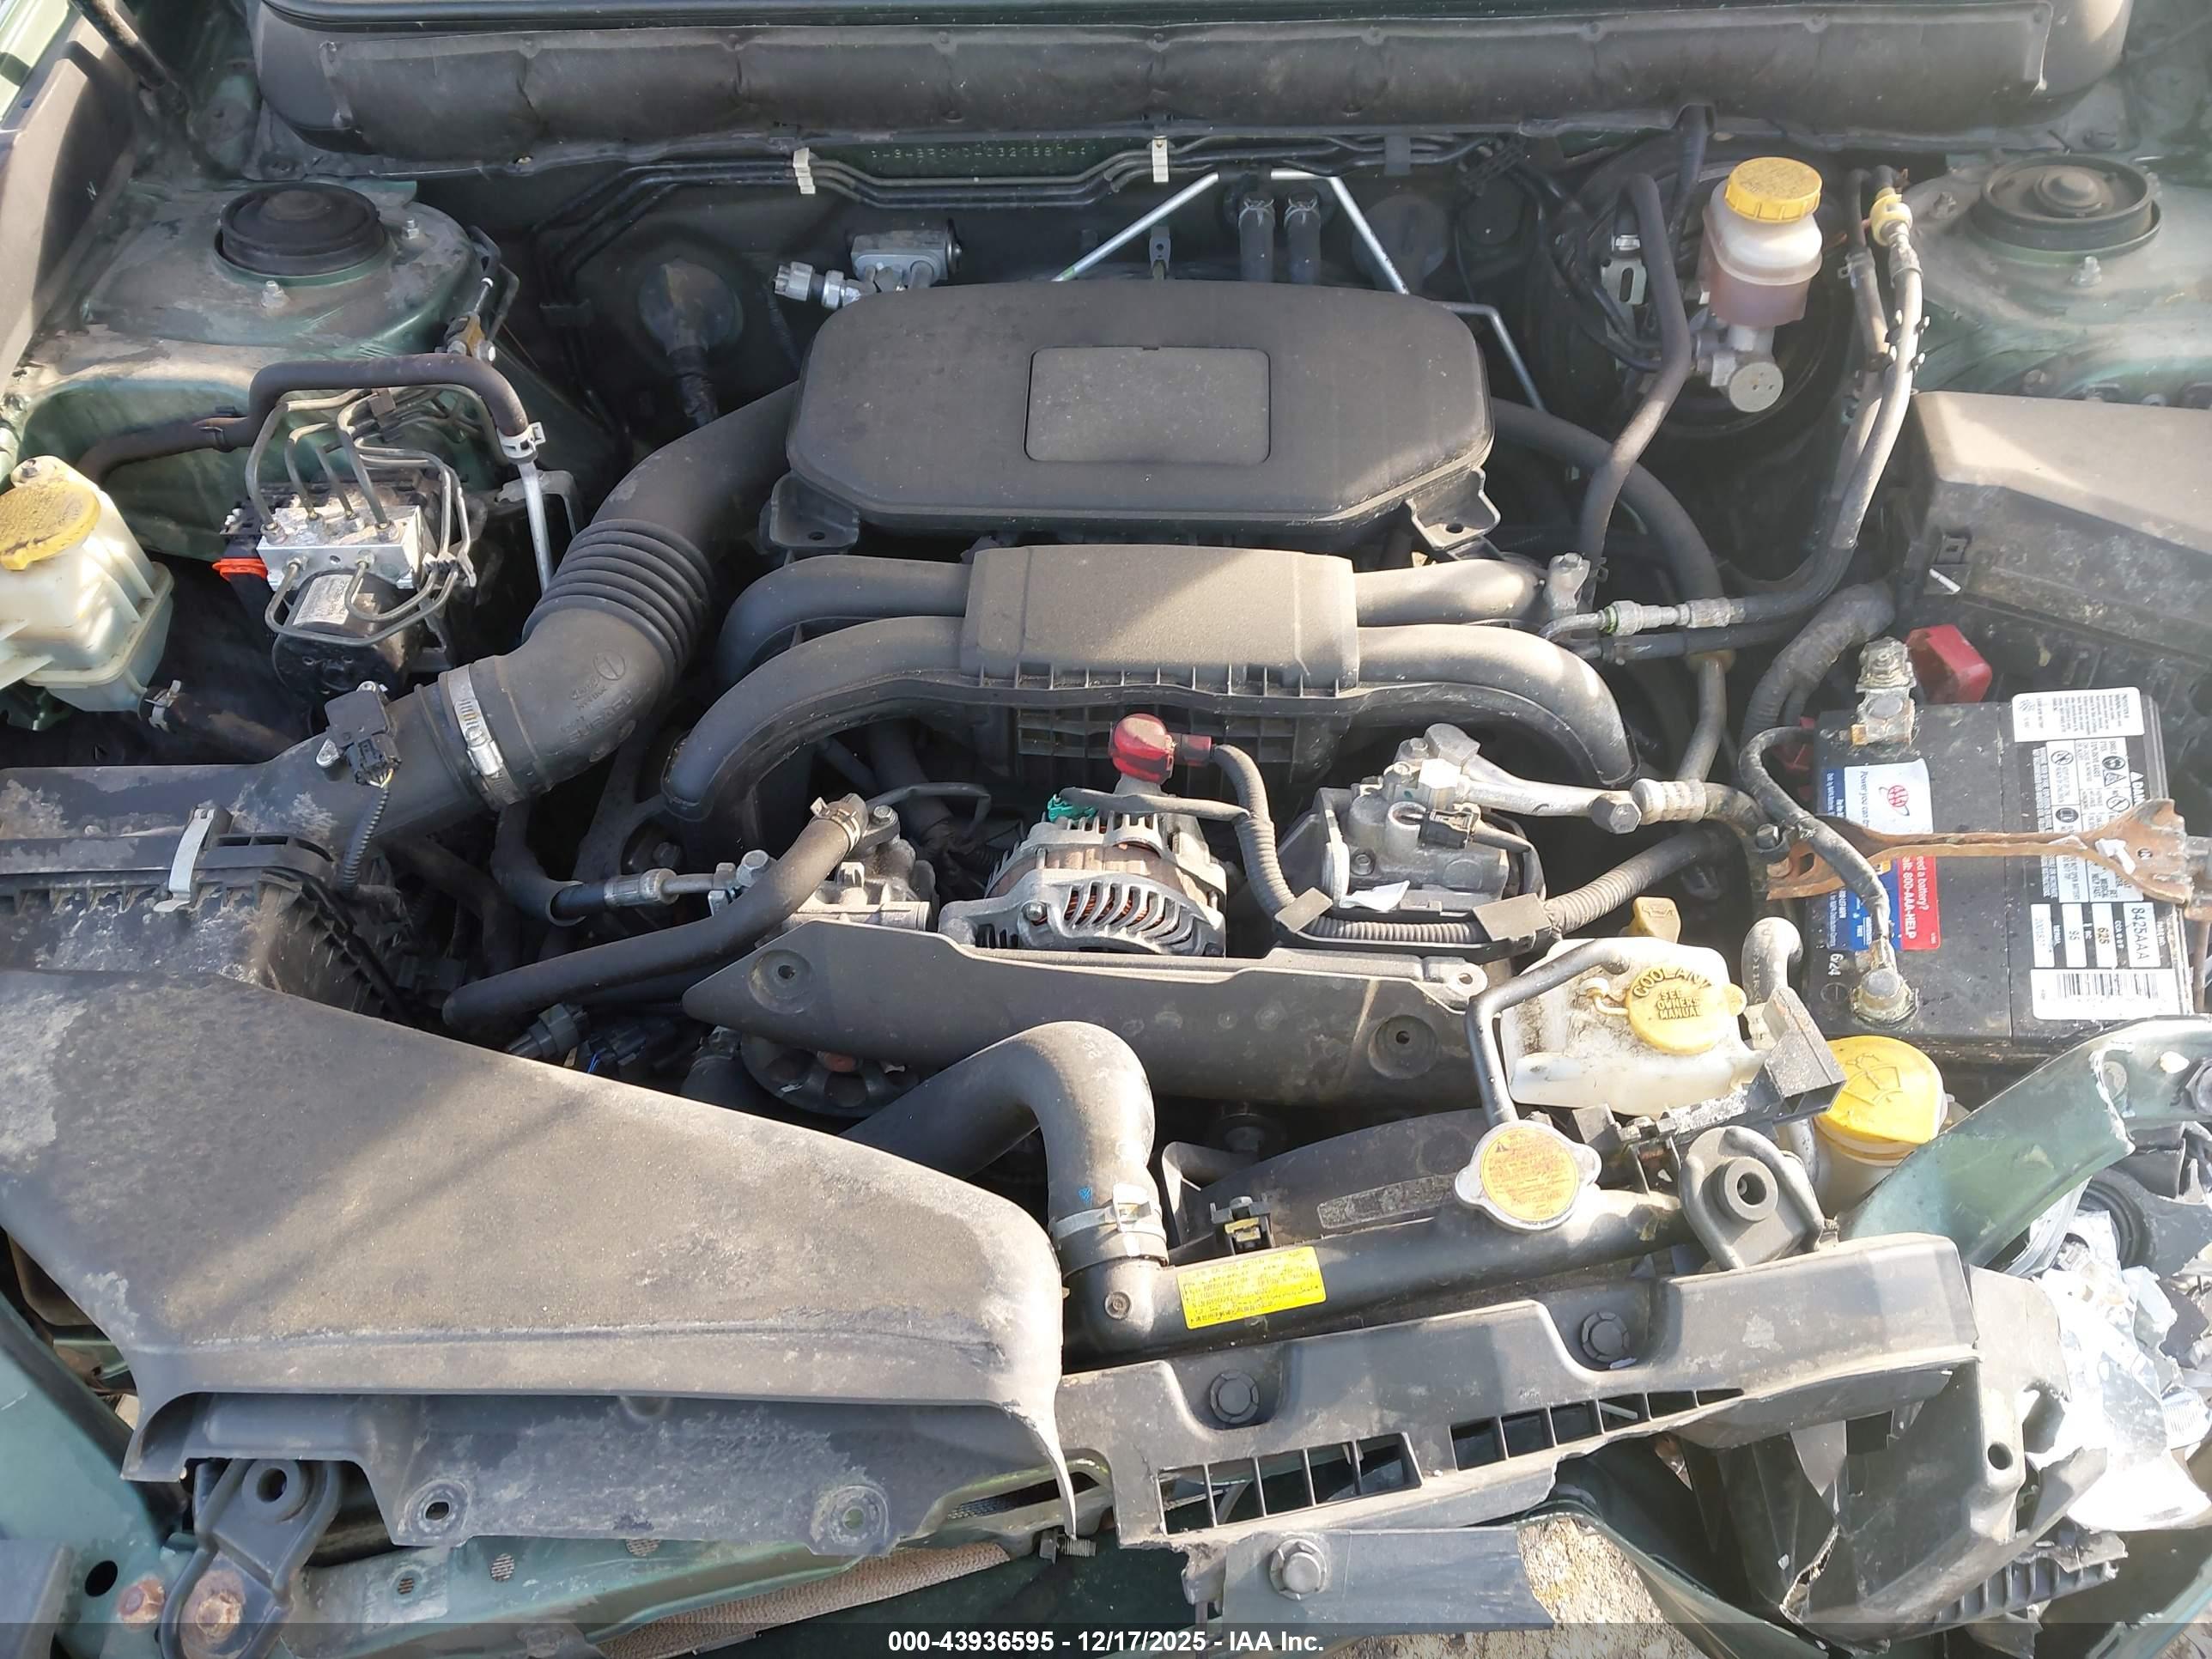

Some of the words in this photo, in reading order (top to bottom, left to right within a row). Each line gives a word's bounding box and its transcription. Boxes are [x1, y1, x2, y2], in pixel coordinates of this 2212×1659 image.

[1860, 771, 1869, 792] Power
[1859, 793, 1868, 805] you
[1917, 856, 1927, 870] eed
[1917, 878, 1929, 910] battery?
[2100, 878, 2108, 898] MEDICAL
[1903, 872, 1917, 939] 800-AAA-HELP
[2069, 930, 2080, 940] 95
[2098, 927, 2109, 945] 625
[2131, 908, 2150, 959] 8425AAA
[1659, 989, 1682, 1000] SEE
[1658, 1008, 1704, 1021] MANUAL
